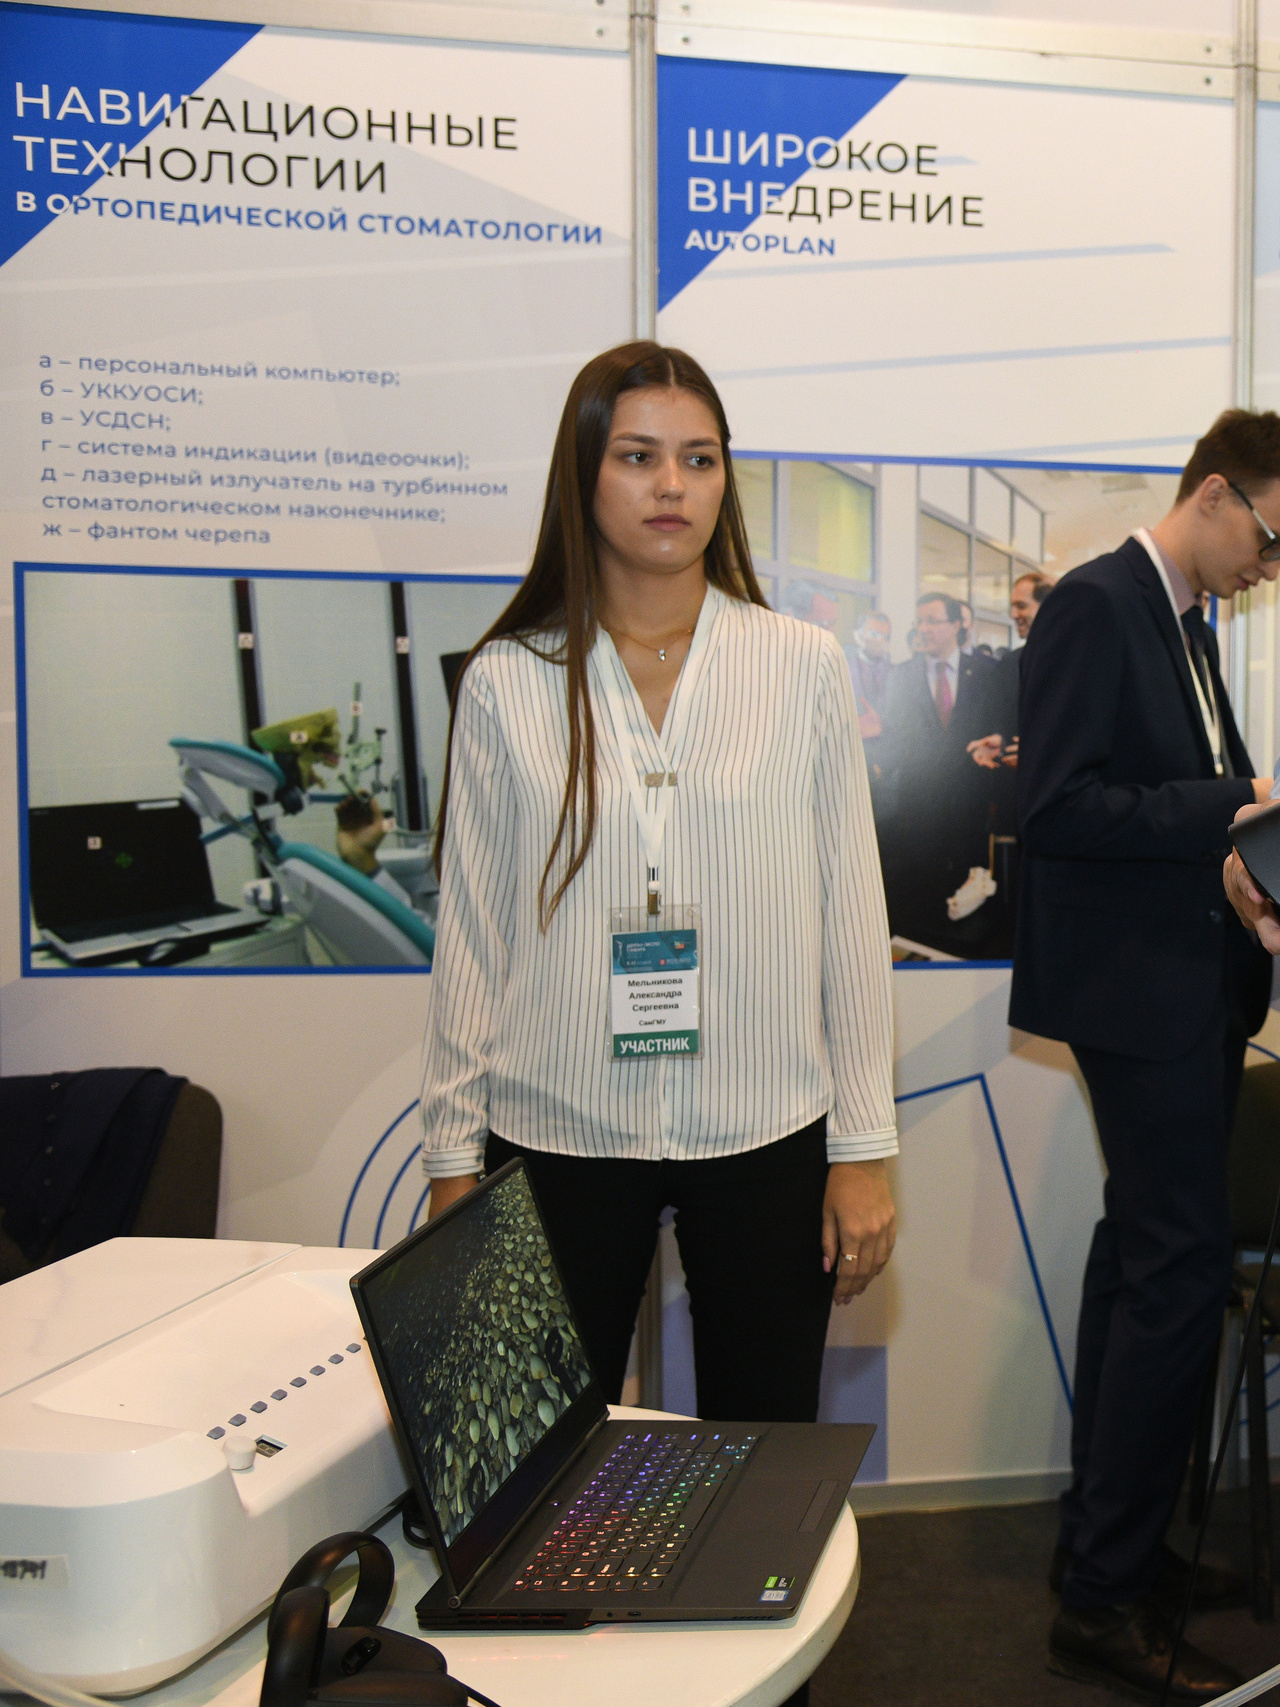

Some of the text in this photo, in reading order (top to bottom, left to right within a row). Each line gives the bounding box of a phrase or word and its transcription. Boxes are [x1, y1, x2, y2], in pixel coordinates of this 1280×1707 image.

[15, 82, 519, 151] НАВИГАЦИОННЫЕ
[13, 136, 387, 195] ТЕХНОЛОГИИ
[687, 127, 938, 177] ШИРОКОЕ
[688, 177, 985, 228] ВНЕДРЕНИЕ
[17, 191, 603, 245] В ОРТОПЕДИЧЕСКОЙ СТОМАТОЛОГИИ
[684, 229, 836, 256] AUTOPLAN
[39, 355, 52, 369] а
[79, 356, 257, 379] персональный
[265, 364, 401, 388] компьютер;
[40, 378, 55, 397] б
[81, 381, 204, 405] УККУОСИ;
[41, 411, 54, 425] в
[80, 410, 171, 432] УСДСН;
[41, 438, 52, 452] г
[77, 440, 177, 458] система
[184, 445, 318, 464] индикации
[324, 447, 470, 472] (видеоочки);
[40, 467, 57, 483] д
[82, 468, 203, 488] лазерный
[210, 474, 342, 493] излучатель
[349, 478, 375, 493] на
[381, 476, 508, 498] турбинном
[42, 495, 446, 524] стоматологическом наконечнике;
[43, 523, 62, 537] ж
[87, 521, 178, 542] фантом
[185, 526, 271, 546] черепа
[628, 978, 683, 988] Мельникова
[629, 990, 682, 1001] Александра
[632, 1003, 679, 1013] Сергеевна
[620, 1037, 690, 1054] УЧАСТНИК
